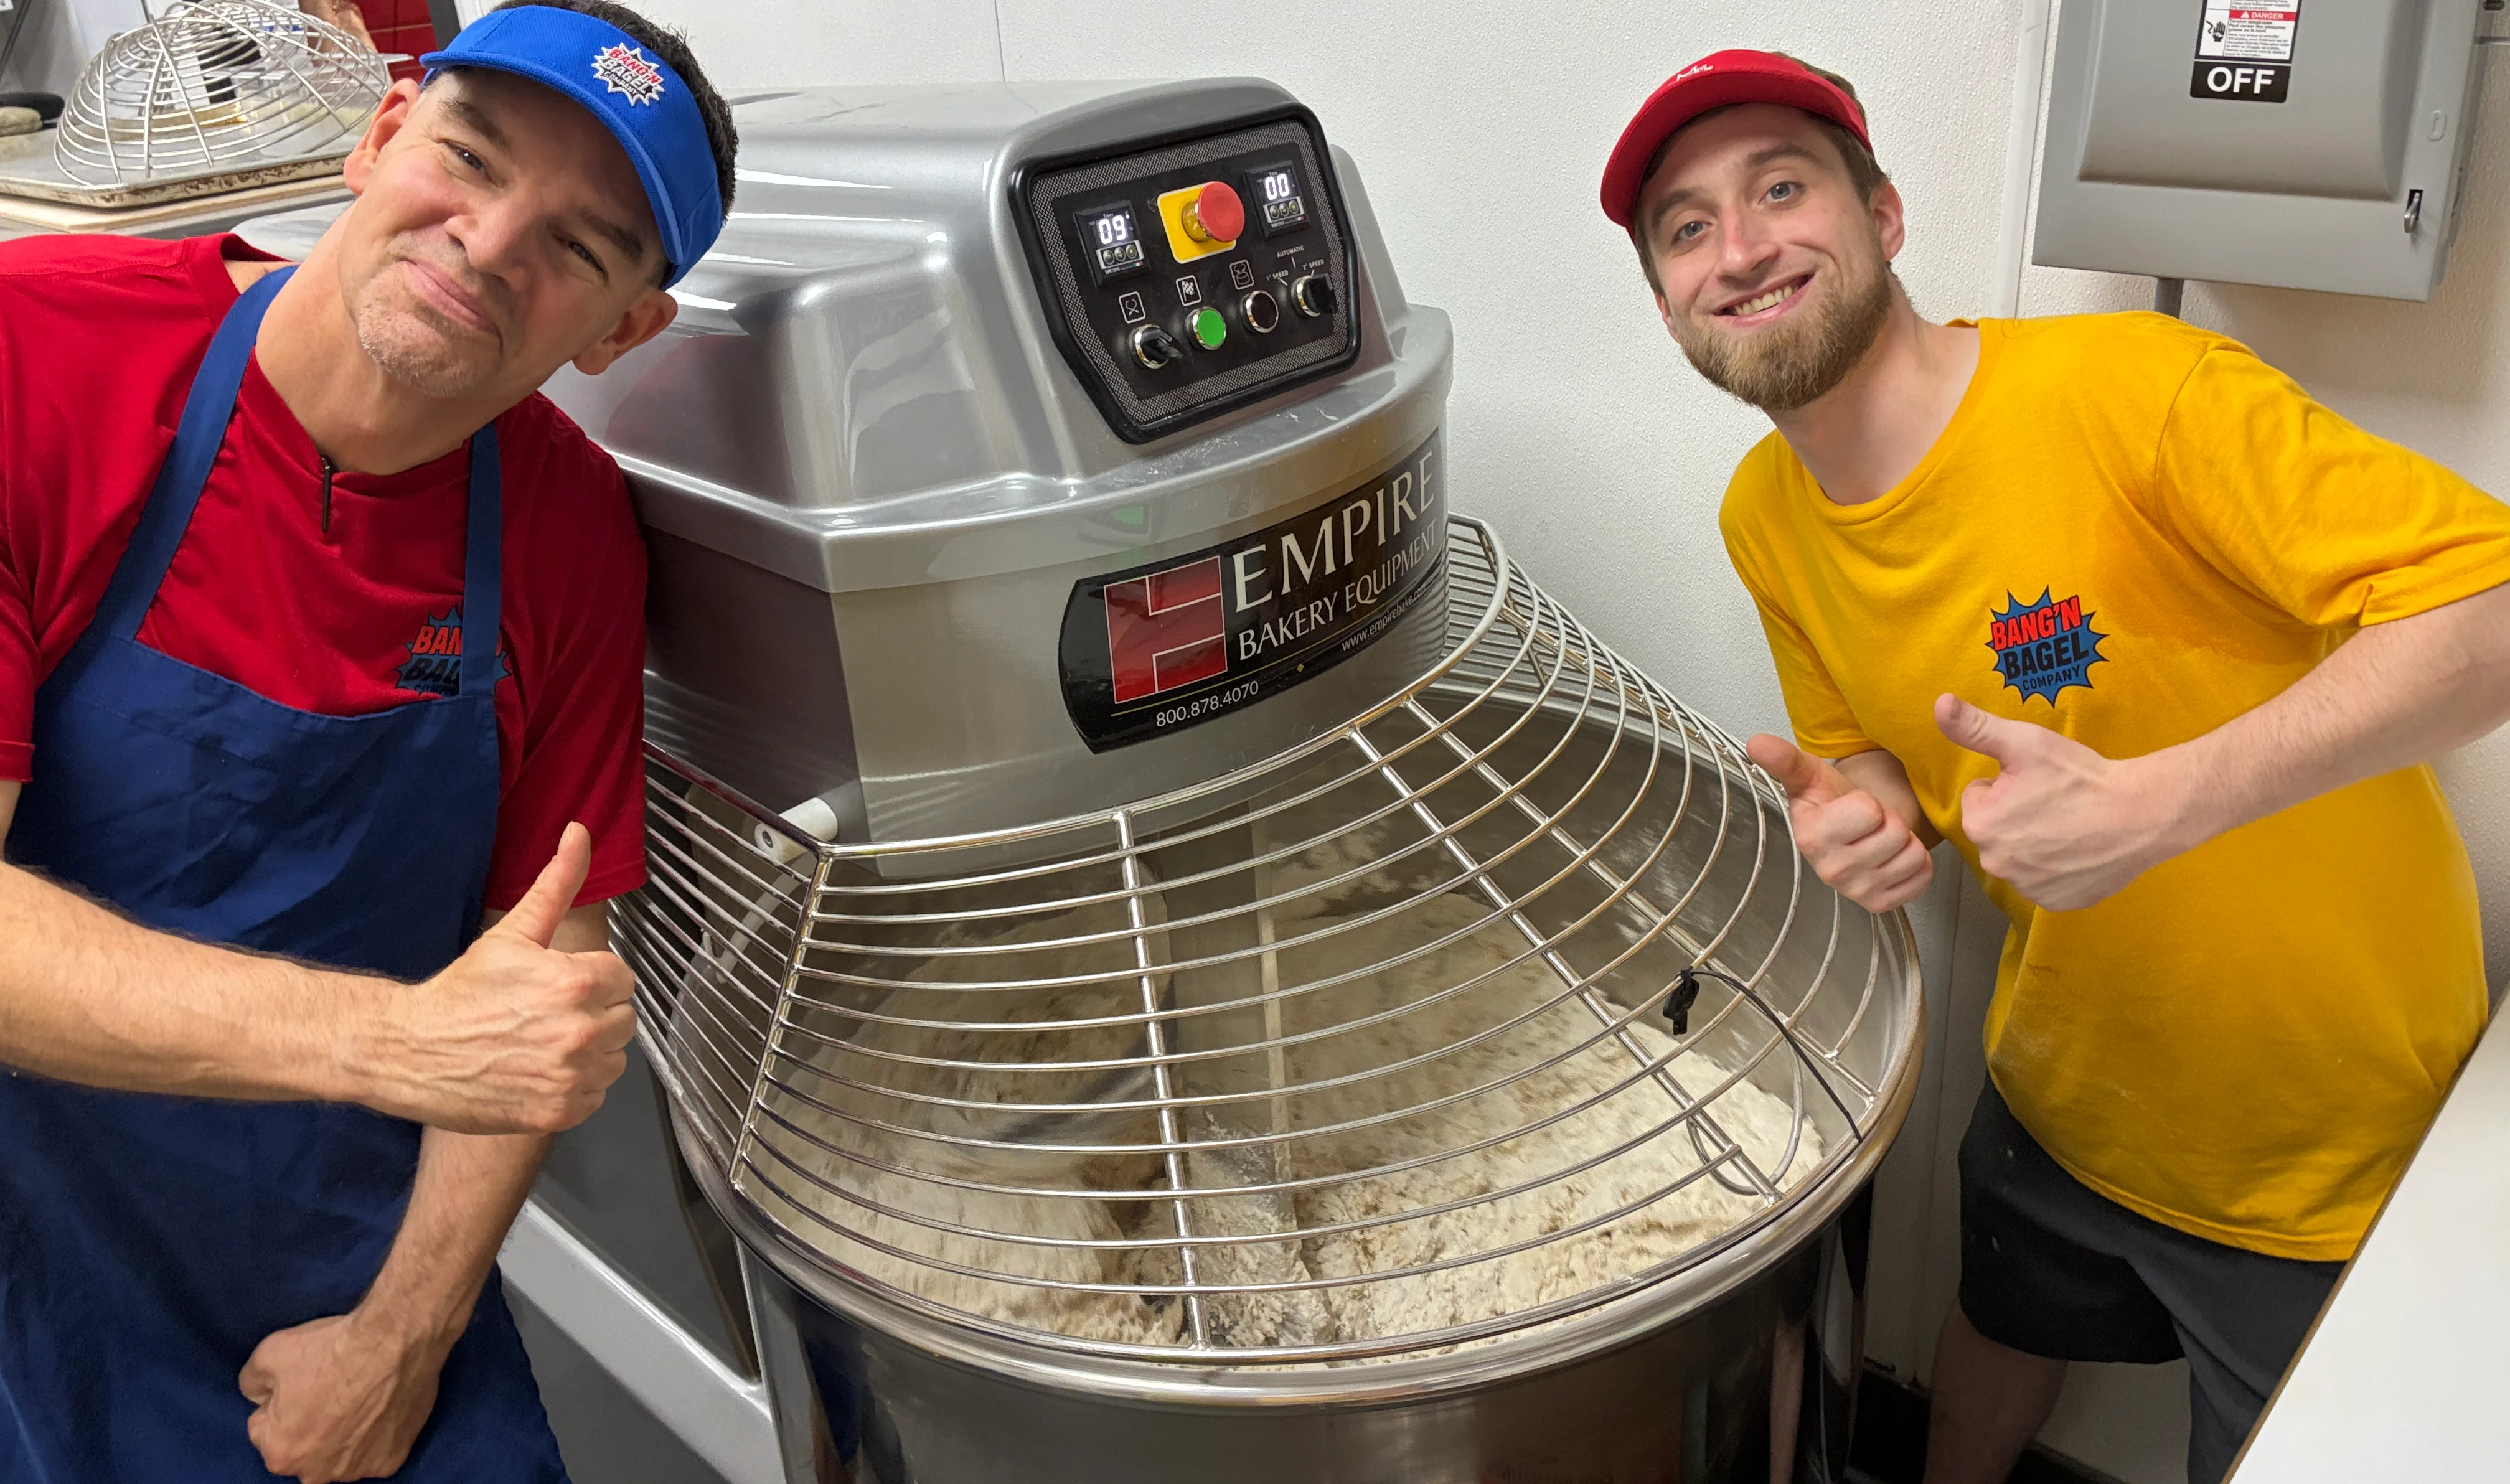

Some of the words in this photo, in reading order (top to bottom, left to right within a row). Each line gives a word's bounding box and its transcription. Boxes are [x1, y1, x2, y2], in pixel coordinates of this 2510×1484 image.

[2251, 12, 2284, 20] DANGER
[601, 59, 649, 94] BAGEL
[604, 71, 639, 95] COMPANY
[2207, 66, 2275, 94] OFF
[1265, 172, 1290, 200] 00
[1098, 214, 1127, 244] 09
[1277, 245, 1305, 258] AUTOMATIC
[1309, 258, 1325, 268] SPEED
[1272, 270, 1289, 279] SPEED
[1231, 450, 1435, 613] EMPIRE
[1238, 591, 1340, 661] BAKERY
[1345, 518, 1436, 614] EQUIPMENT
[1991, 595, 2082, 650] BANG'N
[2003, 631, 2090, 679] BAGEL
[2023, 665, 2080, 691] COMPANY
[1155, 680, 1259, 727] 800.878.4070
